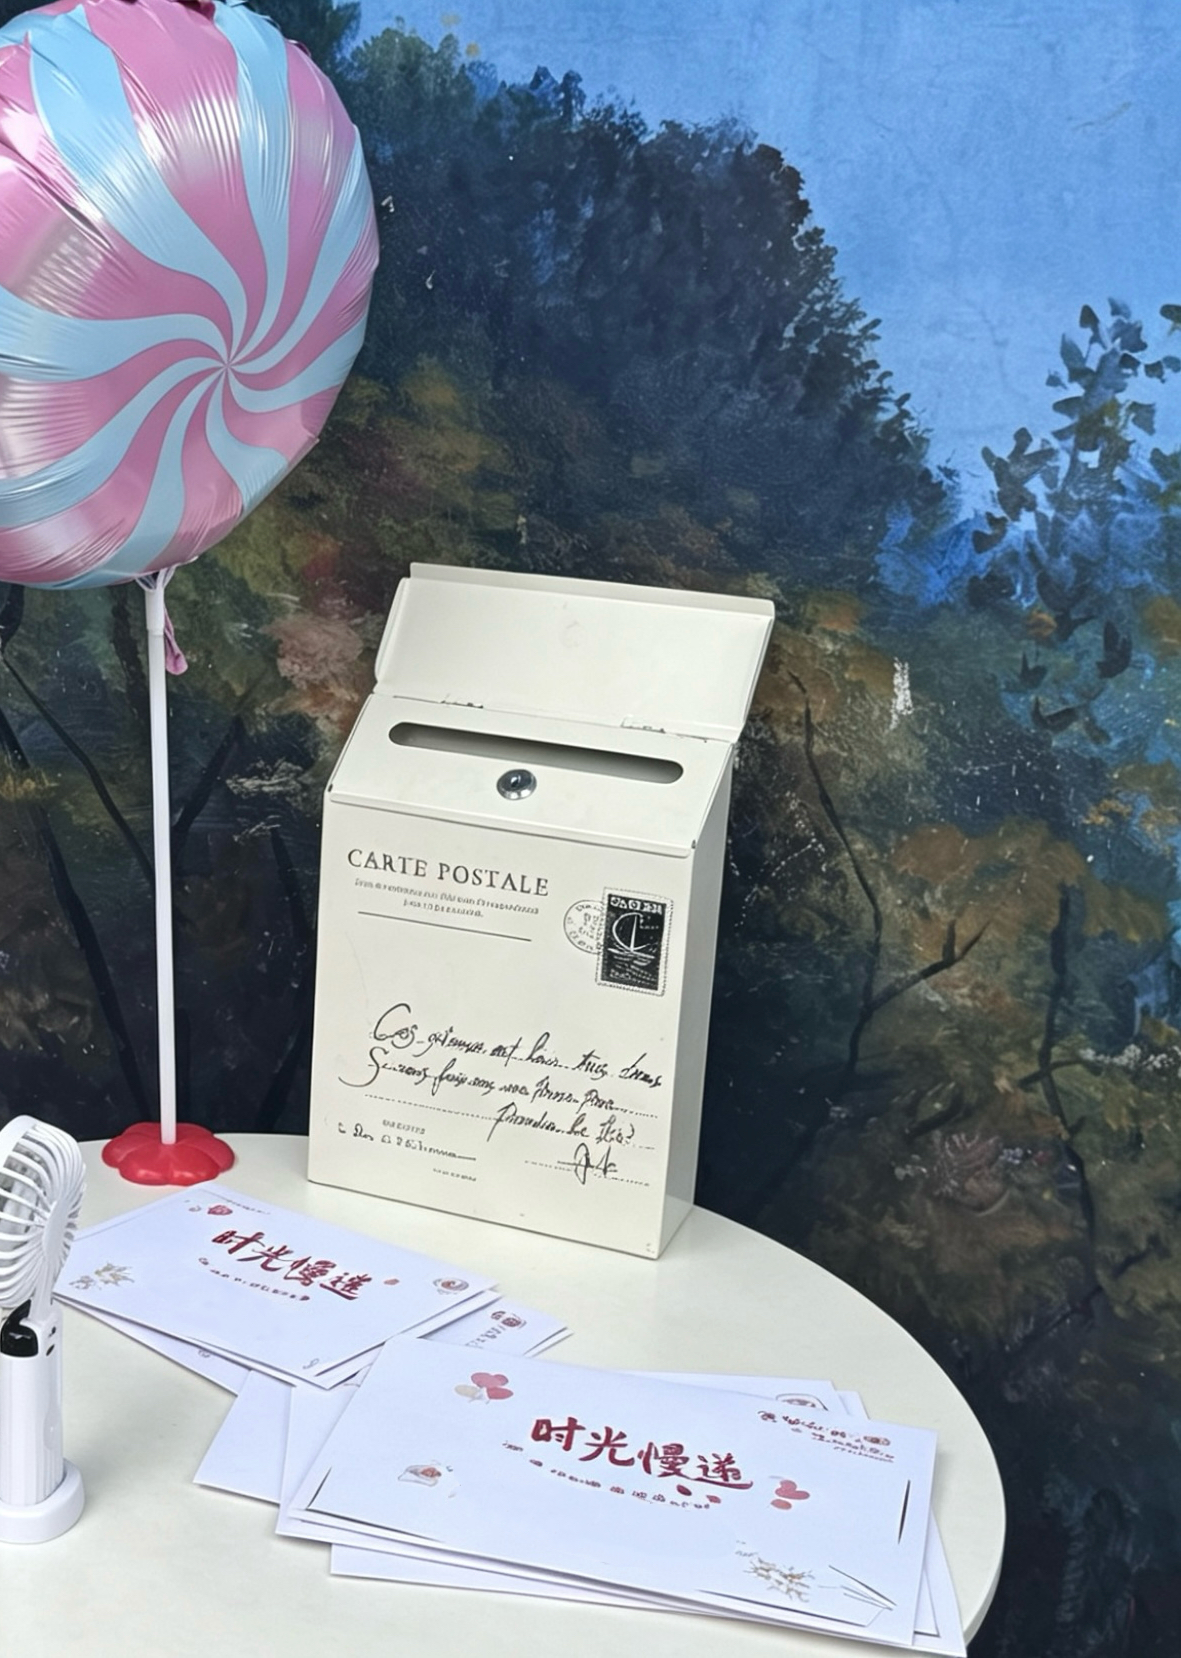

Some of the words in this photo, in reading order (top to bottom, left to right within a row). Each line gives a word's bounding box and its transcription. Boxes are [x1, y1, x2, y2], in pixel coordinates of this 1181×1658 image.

[347, 848, 428, 878] CARTE
[437, 862, 550, 897] POSTALE
[530, 1416, 754, 1490] 时光慢递
